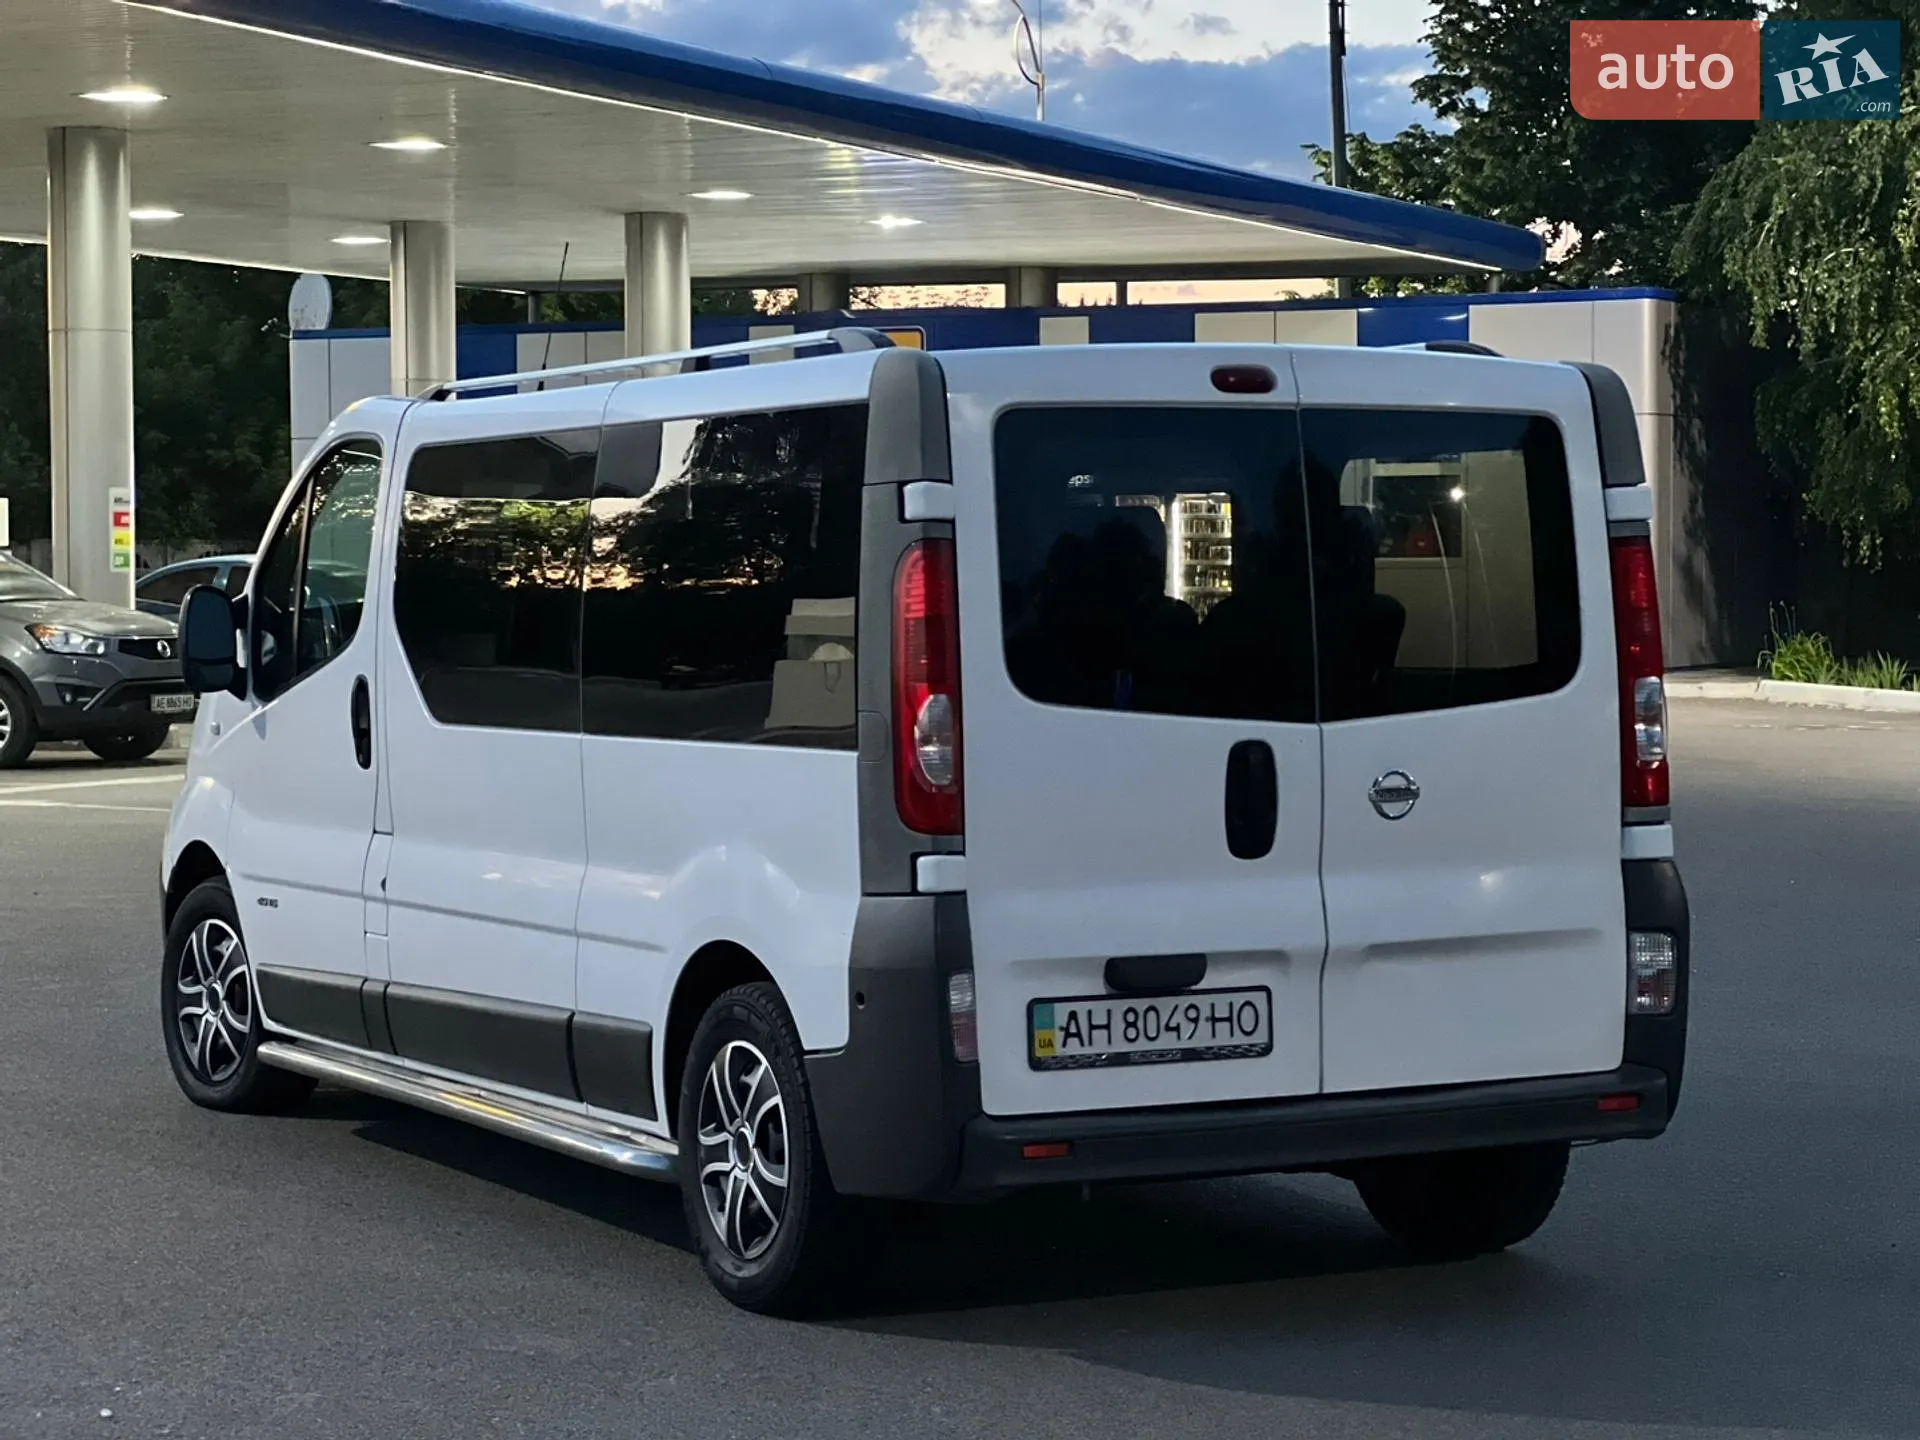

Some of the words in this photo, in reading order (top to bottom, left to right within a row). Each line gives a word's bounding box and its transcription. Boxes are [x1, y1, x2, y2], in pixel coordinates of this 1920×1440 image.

[1061, 1008, 1112, 1048] AH
[1123, 1003, 1200, 1043] 8049
[1038, 1037, 1055, 1049] UA
